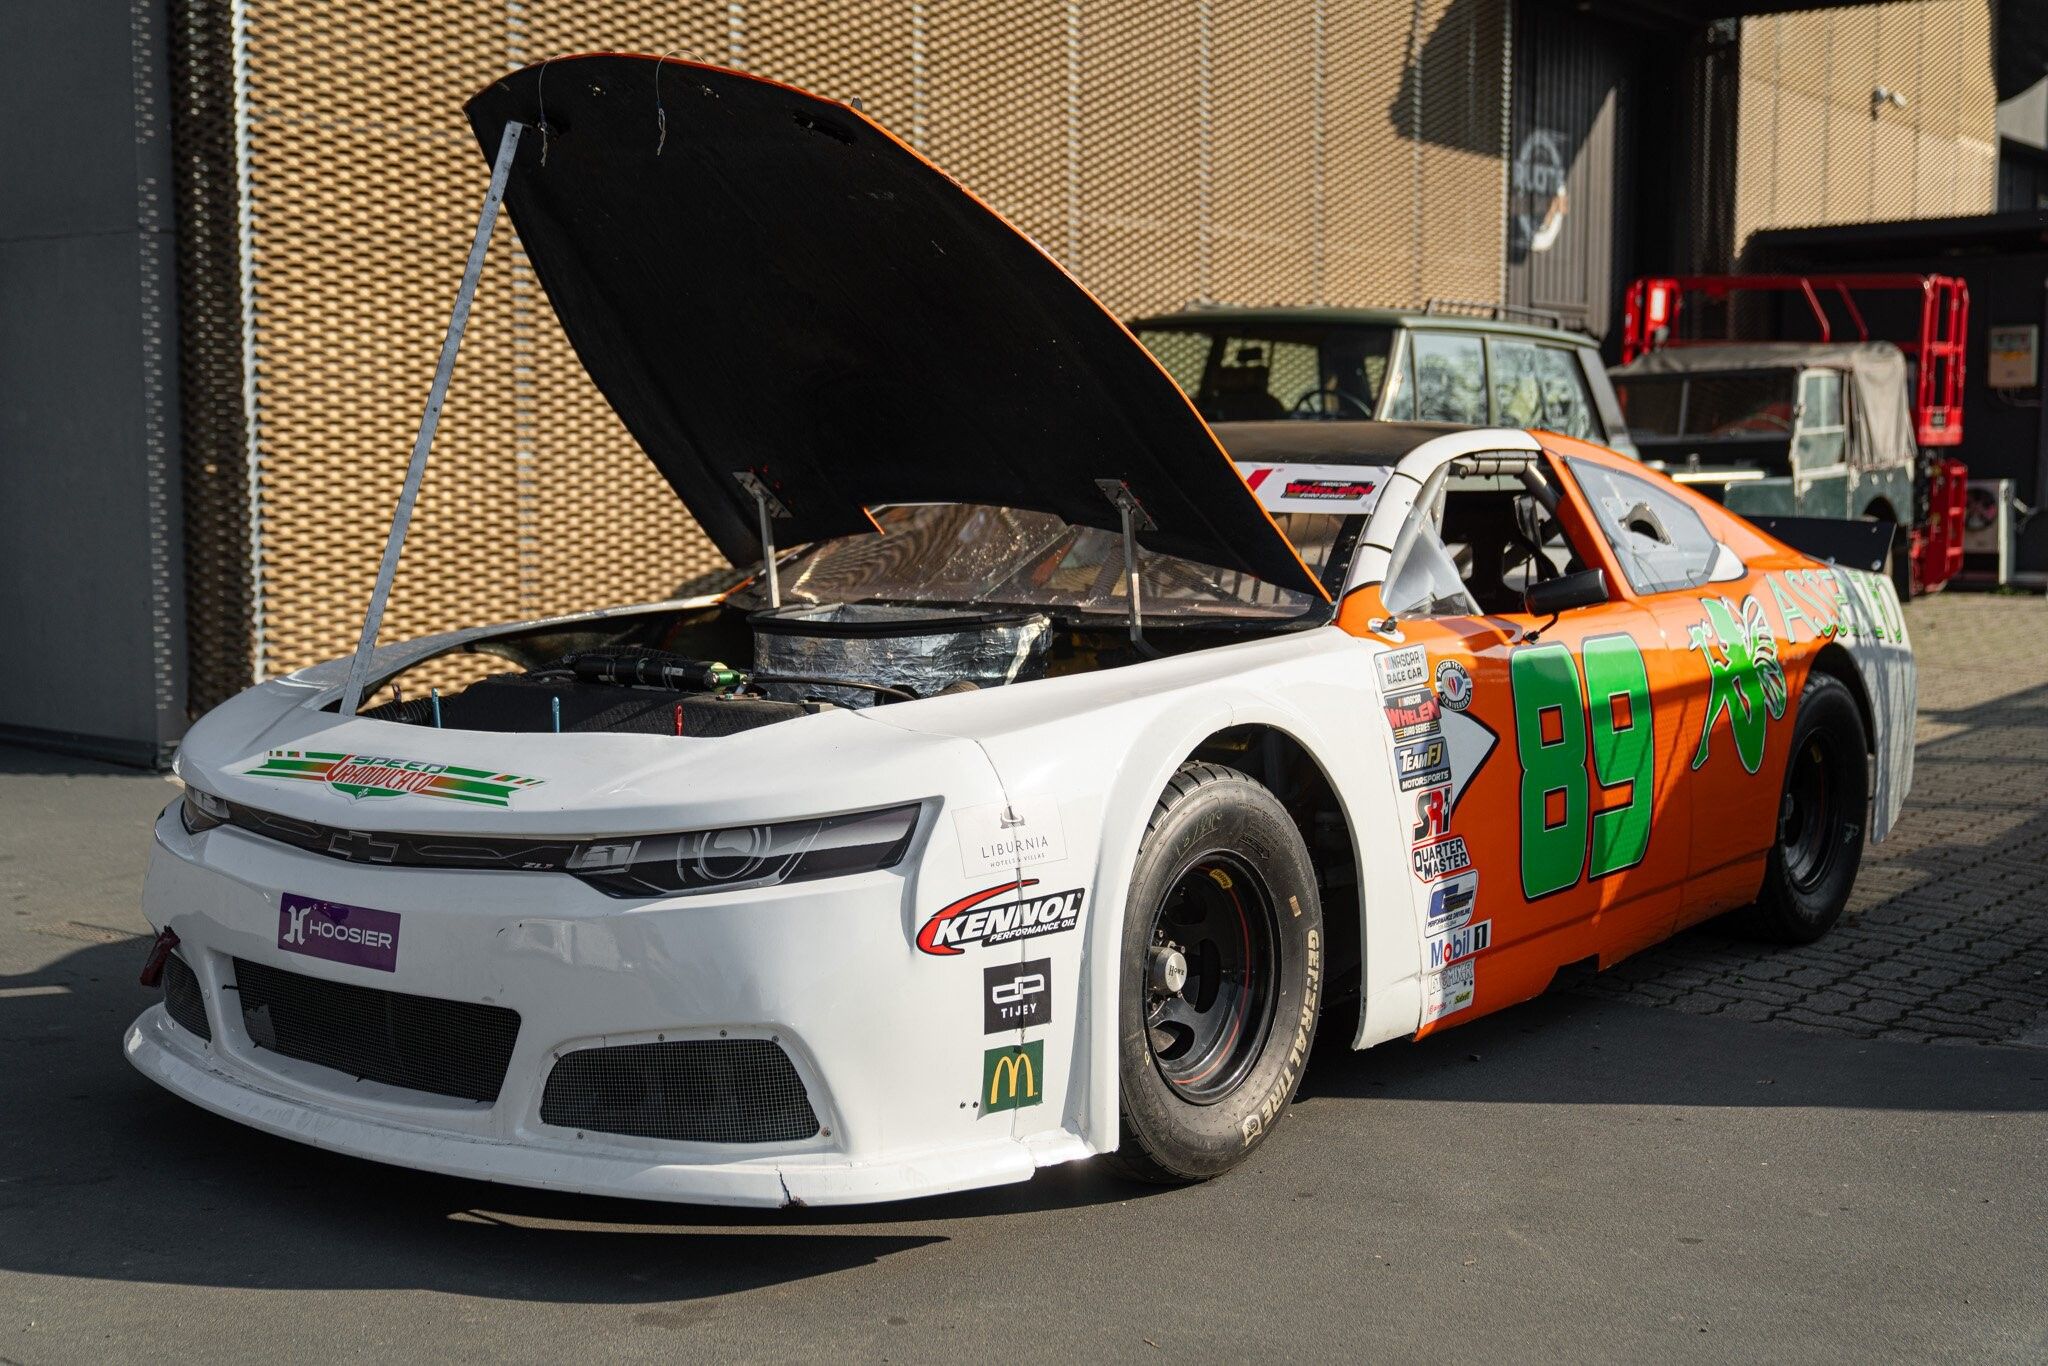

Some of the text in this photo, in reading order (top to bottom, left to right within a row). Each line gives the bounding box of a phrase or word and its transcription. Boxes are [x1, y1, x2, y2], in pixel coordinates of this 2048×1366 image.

[1286, 483, 1375, 494] WHELEN
[1390, 651, 1421, 669] NASCAR
[1387, 667, 1423, 684] RACE CAR
[1384, 697, 1442, 729] WHELEN
[351, 755, 447, 774] SPEED
[1510, 632, 1653, 901] 89
[1402, 771, 1449, 791] MOTORSPORTS
[981, 835, 1049, 859] LIBURNIA
[1414, 838, 1464, 872] QUARTER
[990, 857, 1016, 868] HOTELS
[1423, 852, 1469, 880] MASTER
[931, 892, 1079, 947] KENNOL
[989, 917, 1076, 943] PERFORMANCE OIL
[309, 919, 392, 950] HOOSIER
[1430, 928, 1470, 968] Mobil
[1000, 1002, 1038, 1019] TIJEY
[1261, 929, 1320, 1126] GENERAL TIRE
